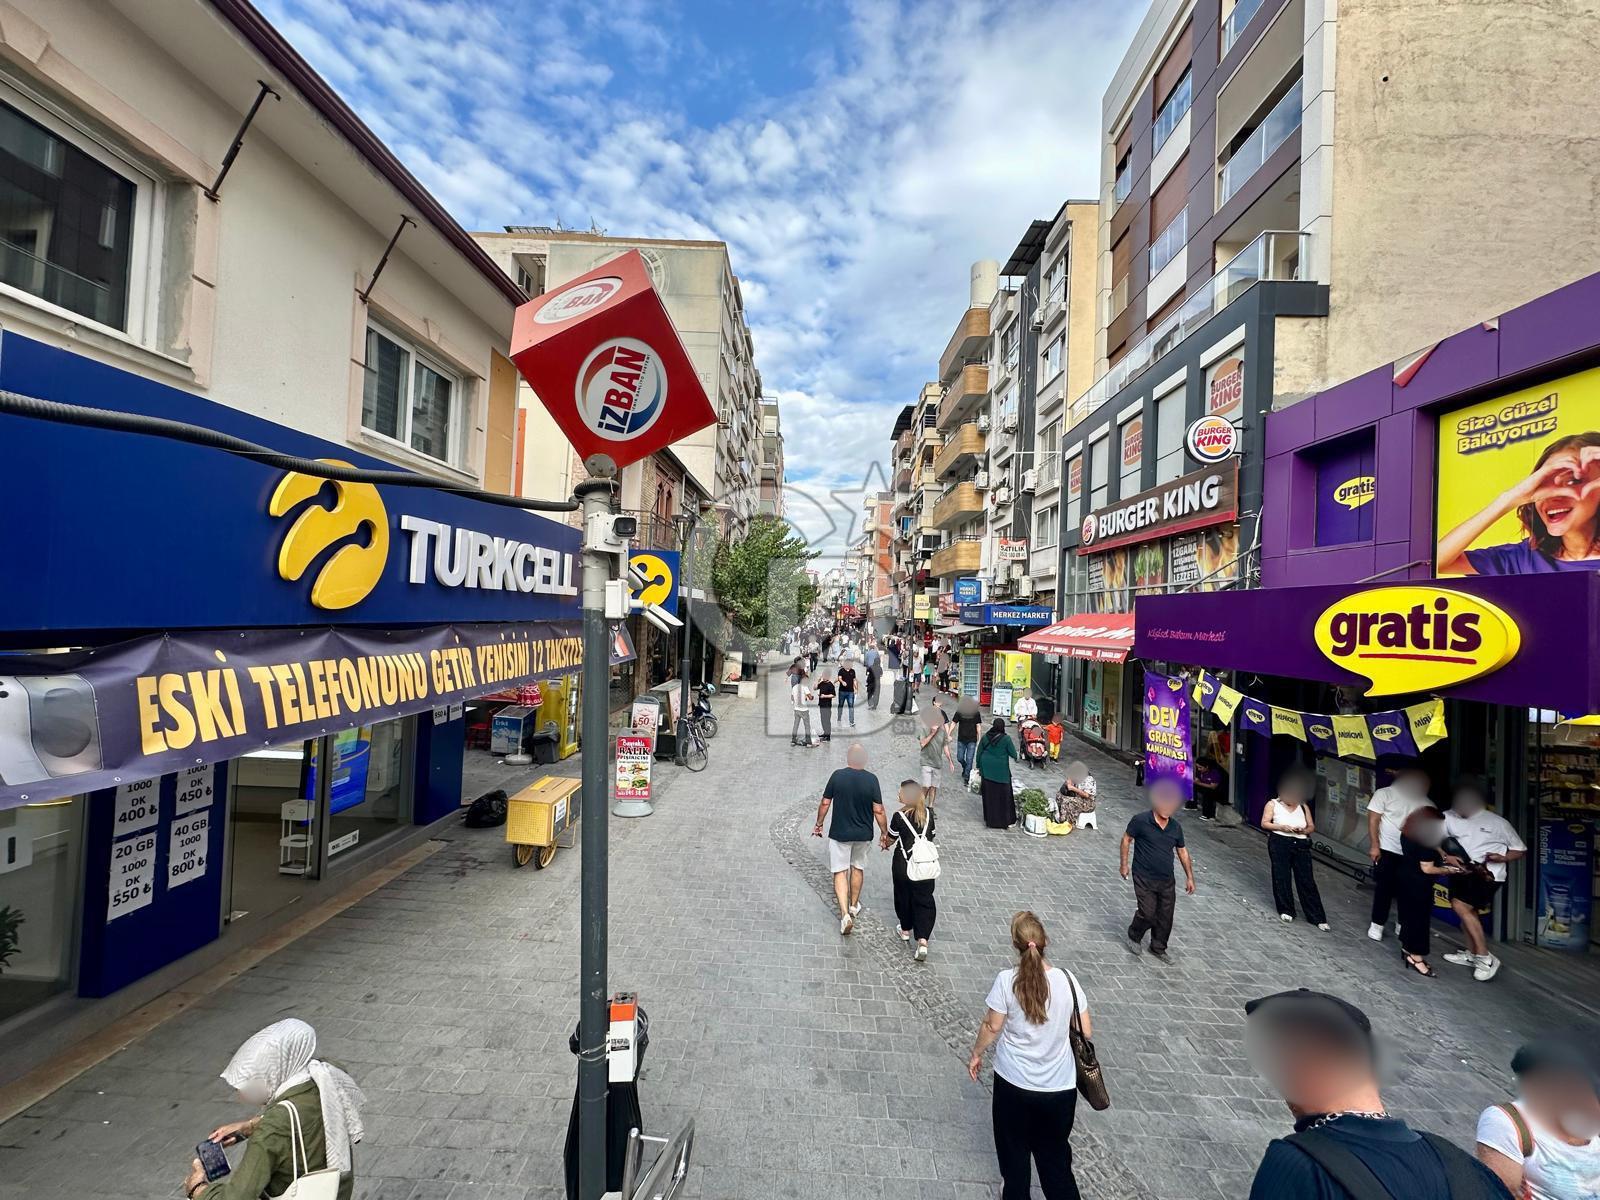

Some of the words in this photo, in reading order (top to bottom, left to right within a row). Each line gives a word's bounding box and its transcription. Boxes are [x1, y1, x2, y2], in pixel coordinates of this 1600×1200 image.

[598, 346, 646, 434] İZBAN
[1211, 371, 1242, 395] BURGER
[1210, 382, 1242, 410] KING
[1457, 414, 1497, 435] Size
[1499, 393, 1558, 423] Güzel
[1197, 427, 1232, 437] BURGER
[1458, 417, 1557, 455] Bakıyoruz
[1196, 435, 1232, 448] KING
[1099, 497, 1159, 538] BURGER
[1163, 475, 1222, 520] KING
[401, 515, 577, 596] TURKCELL
[993, 611, 1020, 619] MERKEZ
[1330, 597, 1482, 657] gratis
[136, 649, 247, 756] ESKİ
[248, 653, 428, 729] TELEFONUNU
[430, 635, 476, 695] GETİR
[476, 632, 529, 684] YENİSİNİ
[532, 640, 543, 673] 12
[545, 629, 583, 671] TAKSİTLE
[638, 717, 650, 726] 50
[1149, 704, 1180, 728] DEV
[127, 780, 152, 793] 1000
[190, 778, 203, 788] DK
[131, 796, 146, 807] DK
[179, 788, 202, 803] 450
[118, 808, 145, 823] 400
[174, 824, 189, 837] 40
[192, 819, 207, 832] GB
[115, 844, 132, 859] 20
[136, 838, 154, 851] GB
[180, 834, 201, 848] 1000
[1539, 825, 1552, 865] Vaseline
[183, 849, 196, 861] DK
[121, 859, 147, 874] 1000
[171, 860, 195, 876] 800
[125, 876, 141, 888] DK
[112, 887, 139, 907] 550
